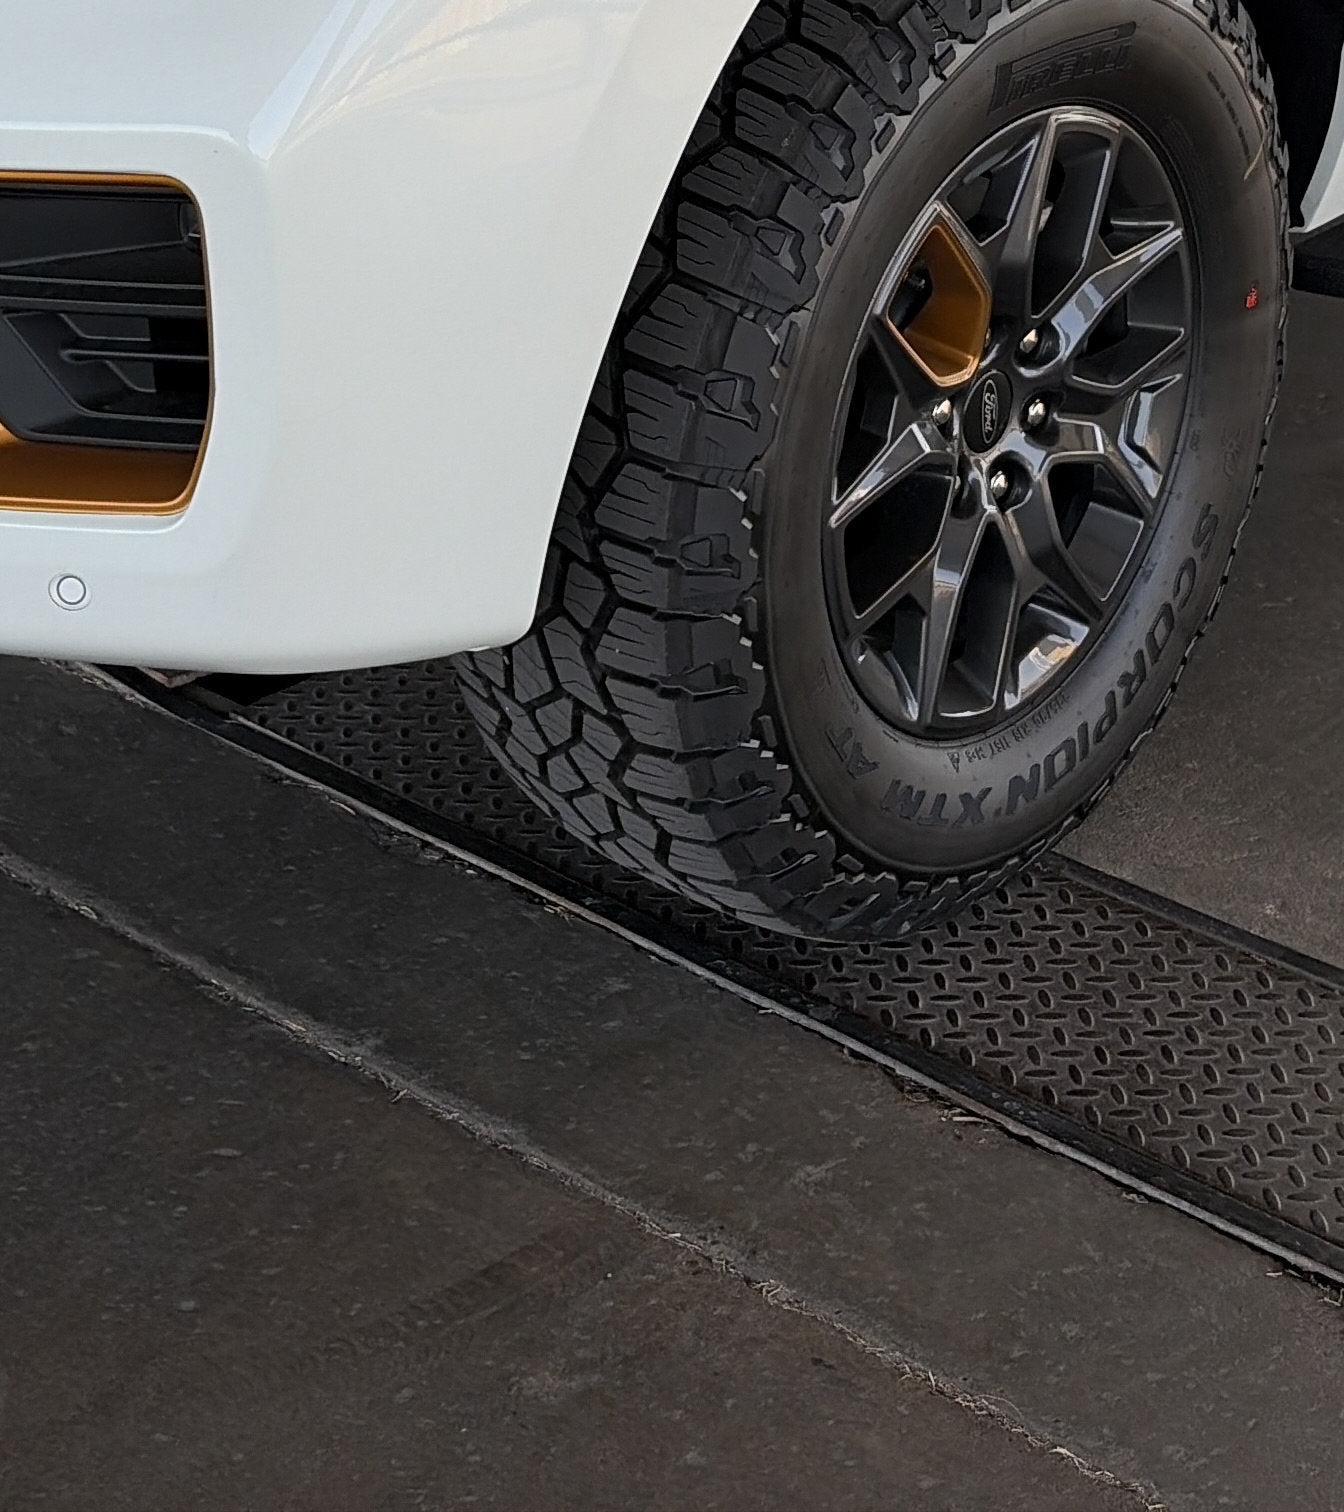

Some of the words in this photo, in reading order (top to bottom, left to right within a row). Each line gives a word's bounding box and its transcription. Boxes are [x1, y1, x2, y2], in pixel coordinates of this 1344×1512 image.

[988, 22, 1137, 114] PIRELLI
[1006, 503, 1219, 816] SCORPION
[881, 779, 993, 828] XTM
